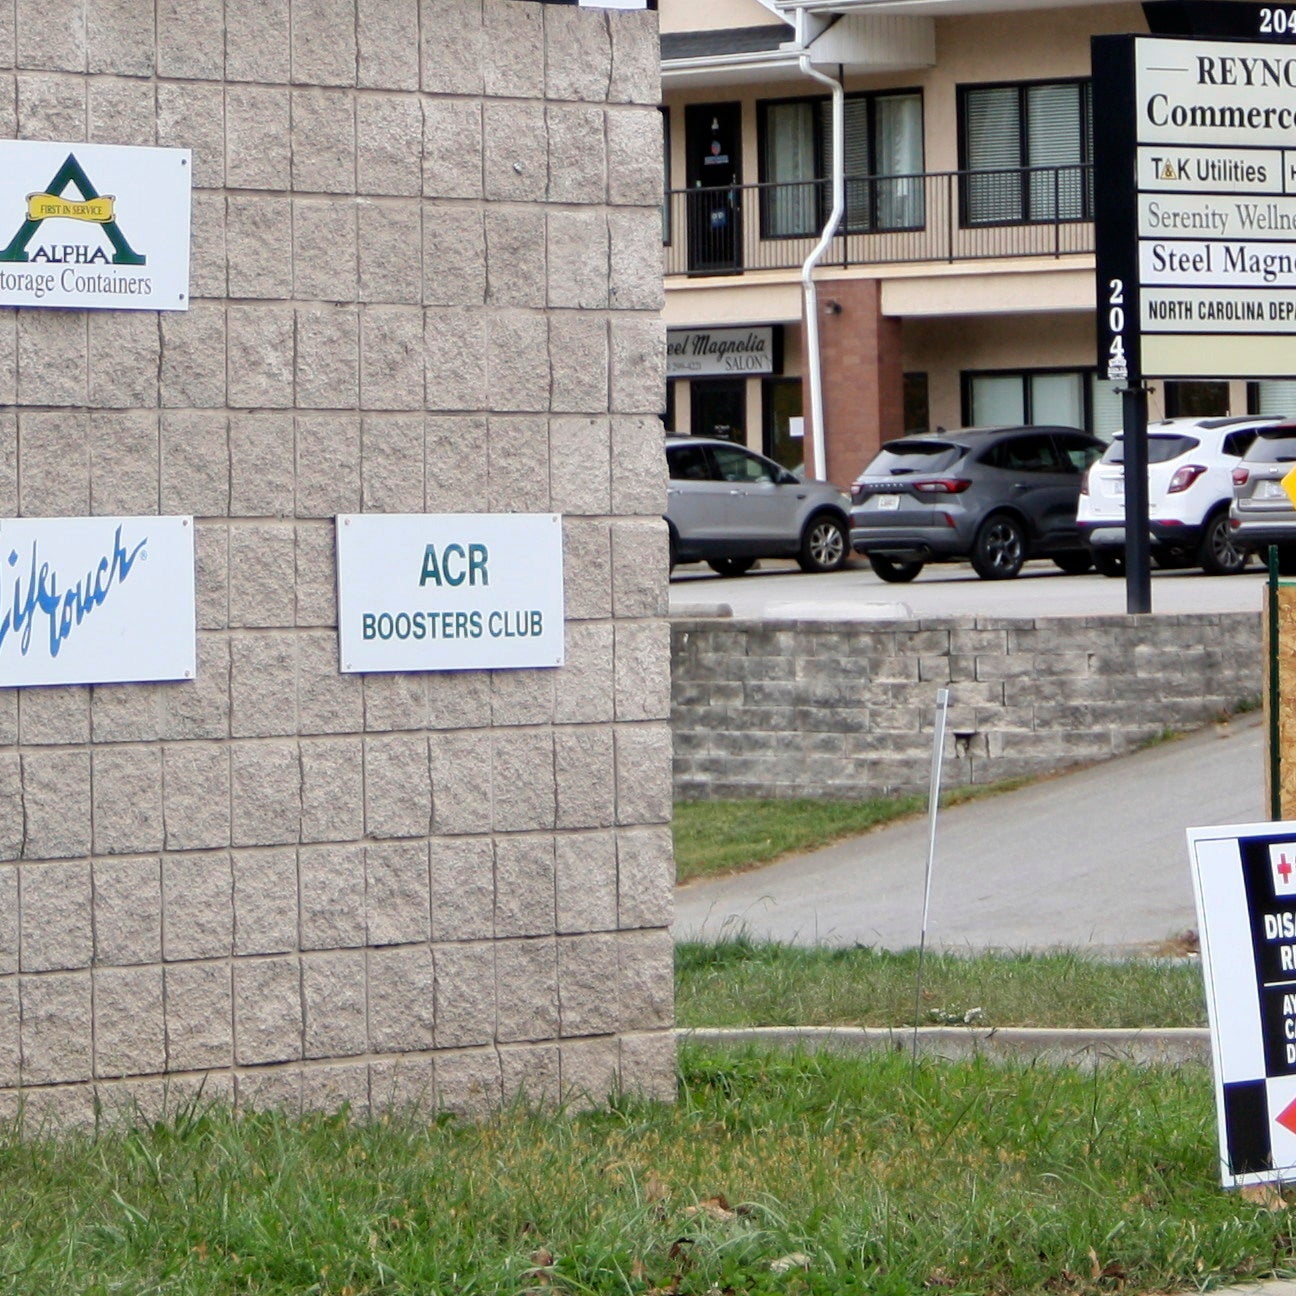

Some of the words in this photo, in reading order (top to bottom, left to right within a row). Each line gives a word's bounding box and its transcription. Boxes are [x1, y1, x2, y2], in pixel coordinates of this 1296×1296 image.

[1151, 157, 1192, 181] T&K
[1196, 159, 1267, 183] Utilities
[40, 204, 61, 214] FIRST
[62, 205, 71, 214] IN
[72, 205, 103, 216] SERVICE
[1147, 202, 1229, 236] Serenity
[30, 245, 112, 264] ALPHA
[1152, 244, 1212, 273] Steel
[60, 268, 152, 295] Containers
[1109, 278, 1125, 360] 204
[1148, 300, 1193, 320] NORTH
[1198, 301, 1264, 321] CAROLINA
[692, 333, 765, 362] Magnolia
[724, 356, 763, 371] SALON
[418, 543, 489, 587] ACR
[362, 610, 483, 640] BOOSTERS
[488, 610, 543, 638] CLUB
